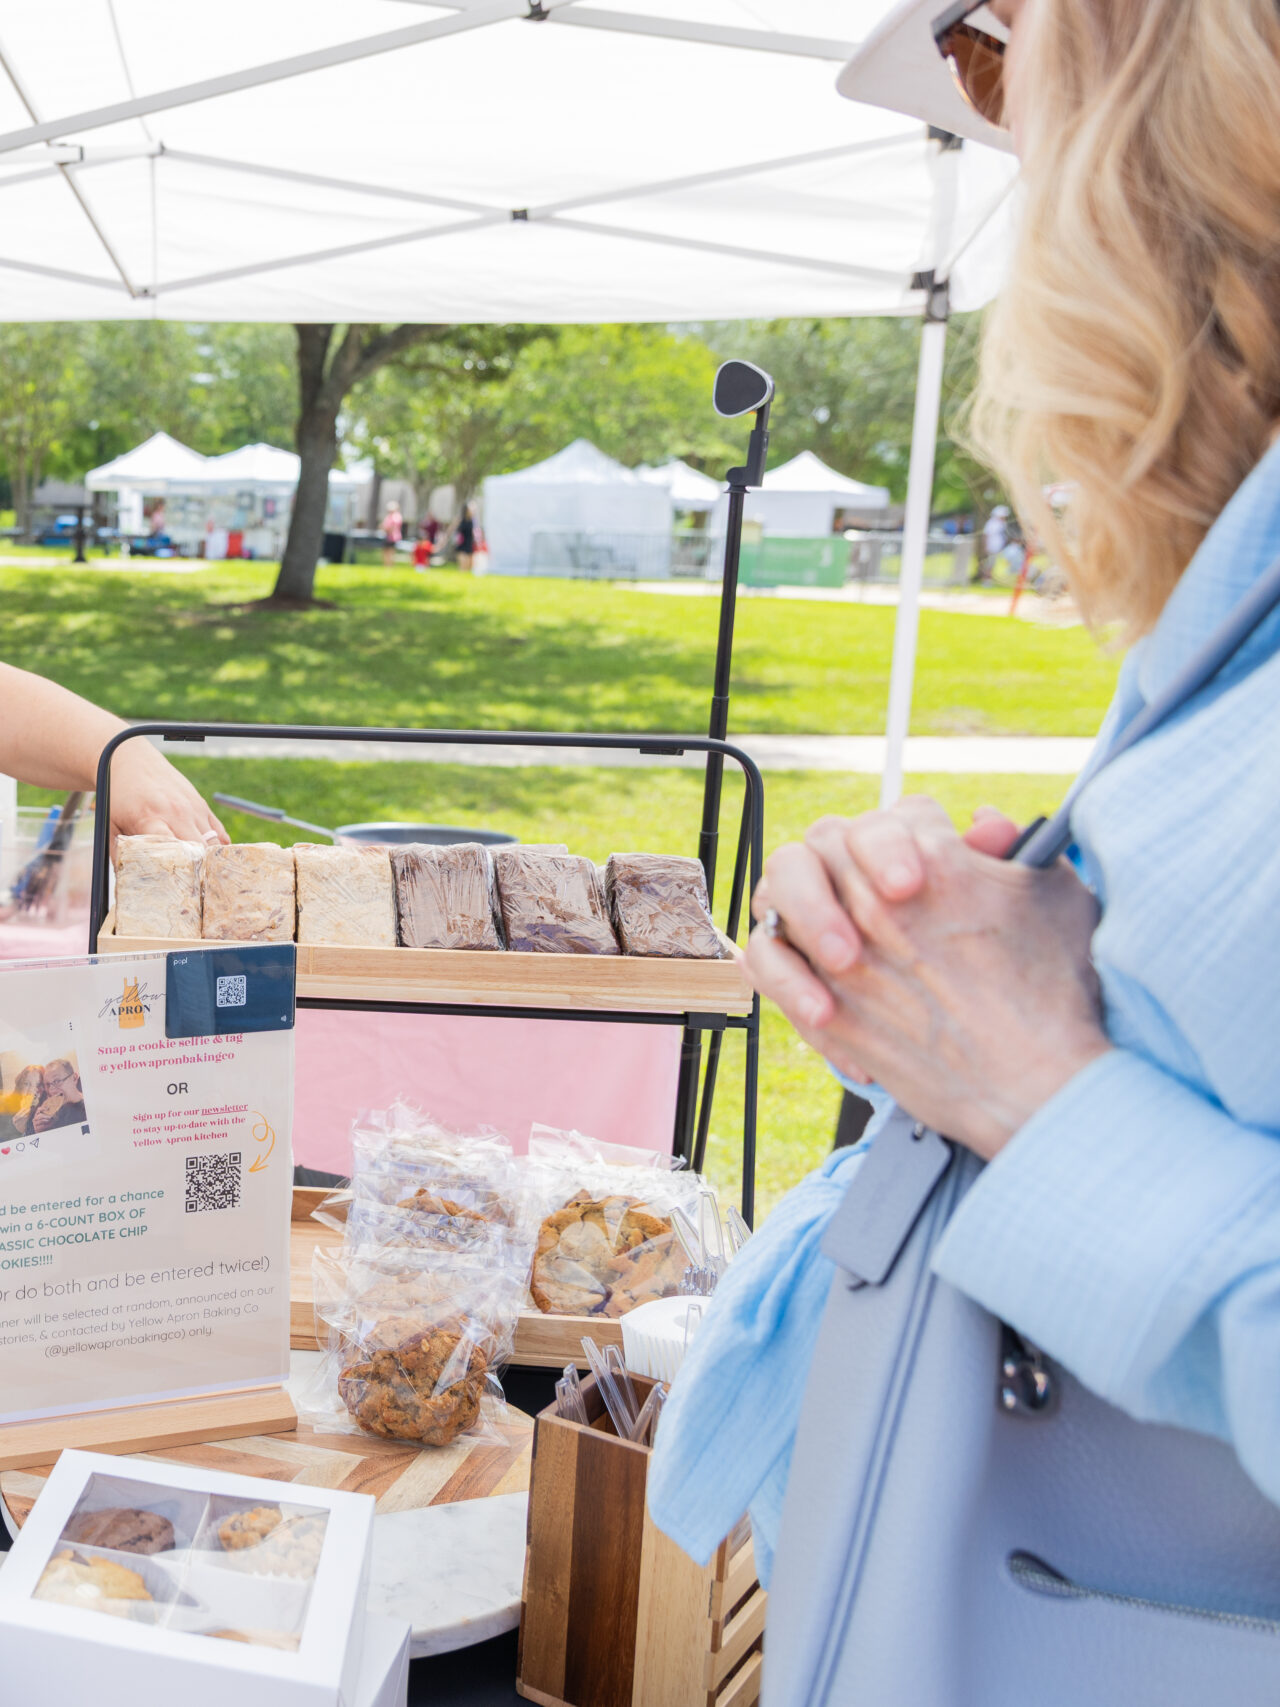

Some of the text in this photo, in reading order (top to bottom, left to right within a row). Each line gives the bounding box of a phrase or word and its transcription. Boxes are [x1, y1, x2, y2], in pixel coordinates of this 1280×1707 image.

[109, 1004, 151, 1016] APRON
[138, 1040, 176, 1052] cookie
[178, 1036, 210, 1048] selfie
[212, 1034, 223, 1044] &
[225, 1032, 243, 1044] tag
[167, 1082, 188, 1094] OR
[154, 1112, 166, 1120] up
[184, 1108, 200, 1116] our
[201, 1104, 248, 1116] newsletter
[132, 1116, 246, 1135] to stay up-to-date with the
[133, 1131, 228, 1148] Yellow Apron kitchen
[10, 1205, 27, 1215] be
[30, 1197, 82, 1213] entered
[85, 1195, 105, 1207] for
[108, 1194, 116, 1204] a
[120, 1189, 165, 1203] chance
[0, 1222, 21, 1234] win
[24, 1222, 33, 1232] a
[37, 1214, 95, 1230] 6-COUNT
[98, 1210, 126, 1223] BOX
[129, 1208, 146, 1220] OF
[38, 1229, 116, 1248] CHOCOLATE
[119, 1225, 148, 1238] CHIP
[15, 1284, 38, 1301] do
[43, 1278, 82, 1297] both
[87, 1273, 119, 1292] and
[124, 1272, 146, 1288] be
[150, 1260, 214, 1284] entered
[219, 1255, 270, 1275] twice!)
[24, 1314, 41, 1326] will
[44, 1313, 59, 1323] be
[62, 1305, 109, 1321] selected
[112, 1303, 123, 1314] at
[126, 1297, 173, 1313] random,
[175, 1289, 237, 1306] announced
[240, 1288, 254, 1298] on
[257, 1286, 275, 1296] our
[39, 1329, 48, 1340] &
[51, 1322, 108, 1339] contacted
[111, 1321, 126, 1332] by
[128, 1316, 164, 1329] Yellow
[167, 1310, 200, 1324] Apron
[203, 1305, 241, 1319] Baking
[243, 1303, 259, 1313] Co
[44, 1329, 186, 1358] (@yellowapronbakingco)
